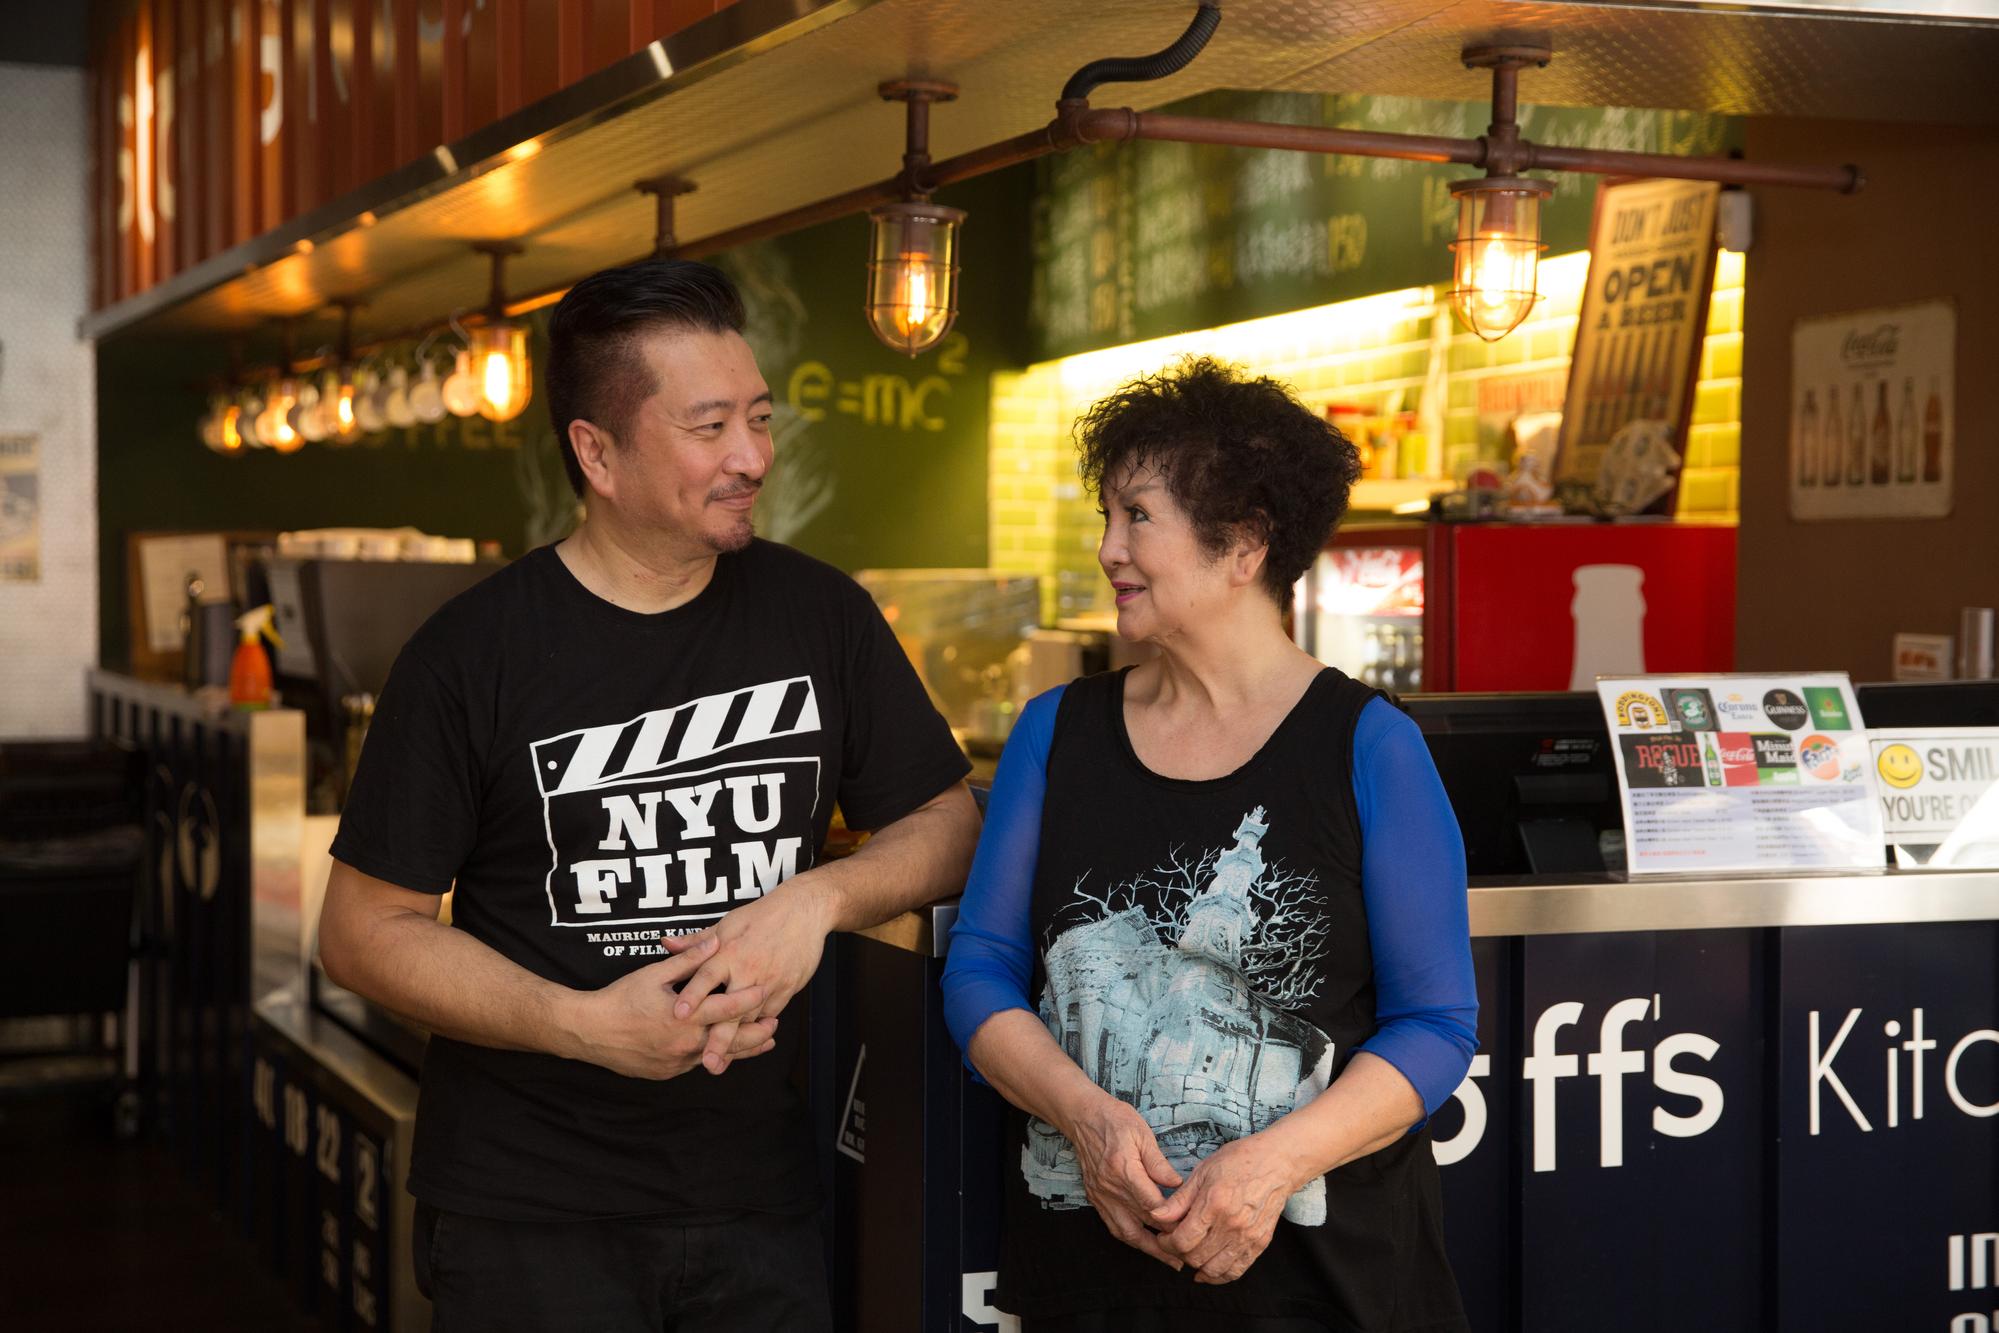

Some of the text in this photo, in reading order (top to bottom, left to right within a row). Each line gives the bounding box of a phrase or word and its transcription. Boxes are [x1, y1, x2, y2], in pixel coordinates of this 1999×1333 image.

[1603, 253, 1697, 304] OPEN
[1620, 300, 1685, 327] BEER
[1765, 704, 1807, 715] GUINNESS
[598, 772, 786, 850] NYU
[1883, 795, 1954, 822] YOU'RE
[570, 836, 802, 914] FILM
[586, 926, 709, 943] MAURICE KAN
[603, 944, 670, 957] OF FILM
